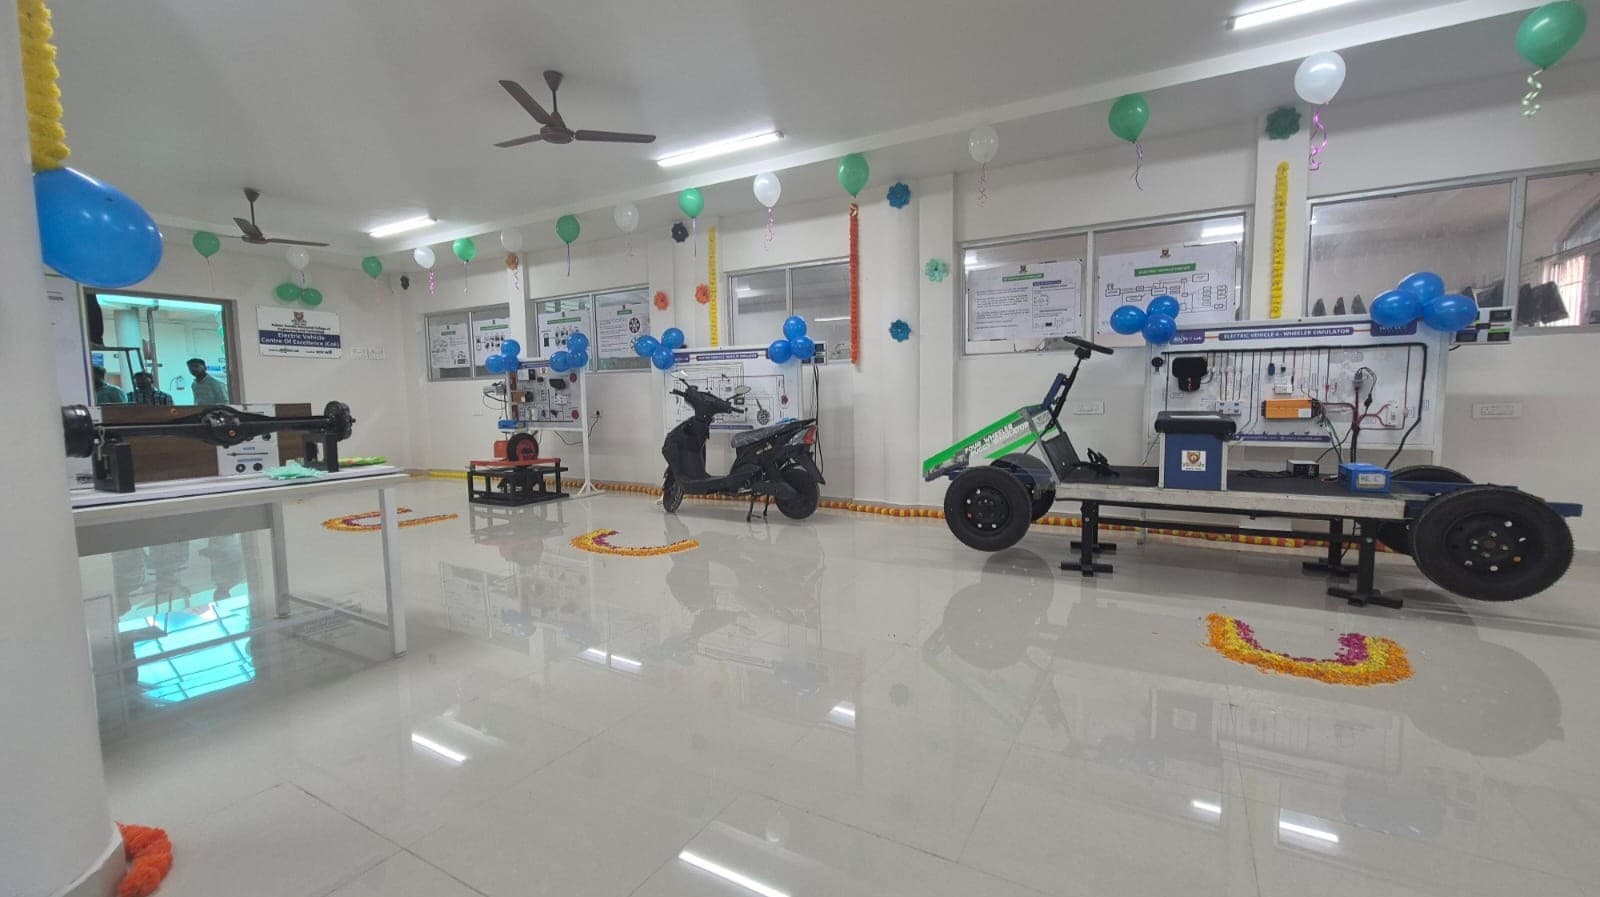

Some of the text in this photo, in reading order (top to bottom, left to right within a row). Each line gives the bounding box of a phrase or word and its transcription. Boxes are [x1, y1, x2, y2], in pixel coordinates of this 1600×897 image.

[1223, 332, 1249, 340] ELECTRIC
[1250, 331, 1274, 339] VEHICLE
[965, 424, 1013, 453] FOUR WHEELER
